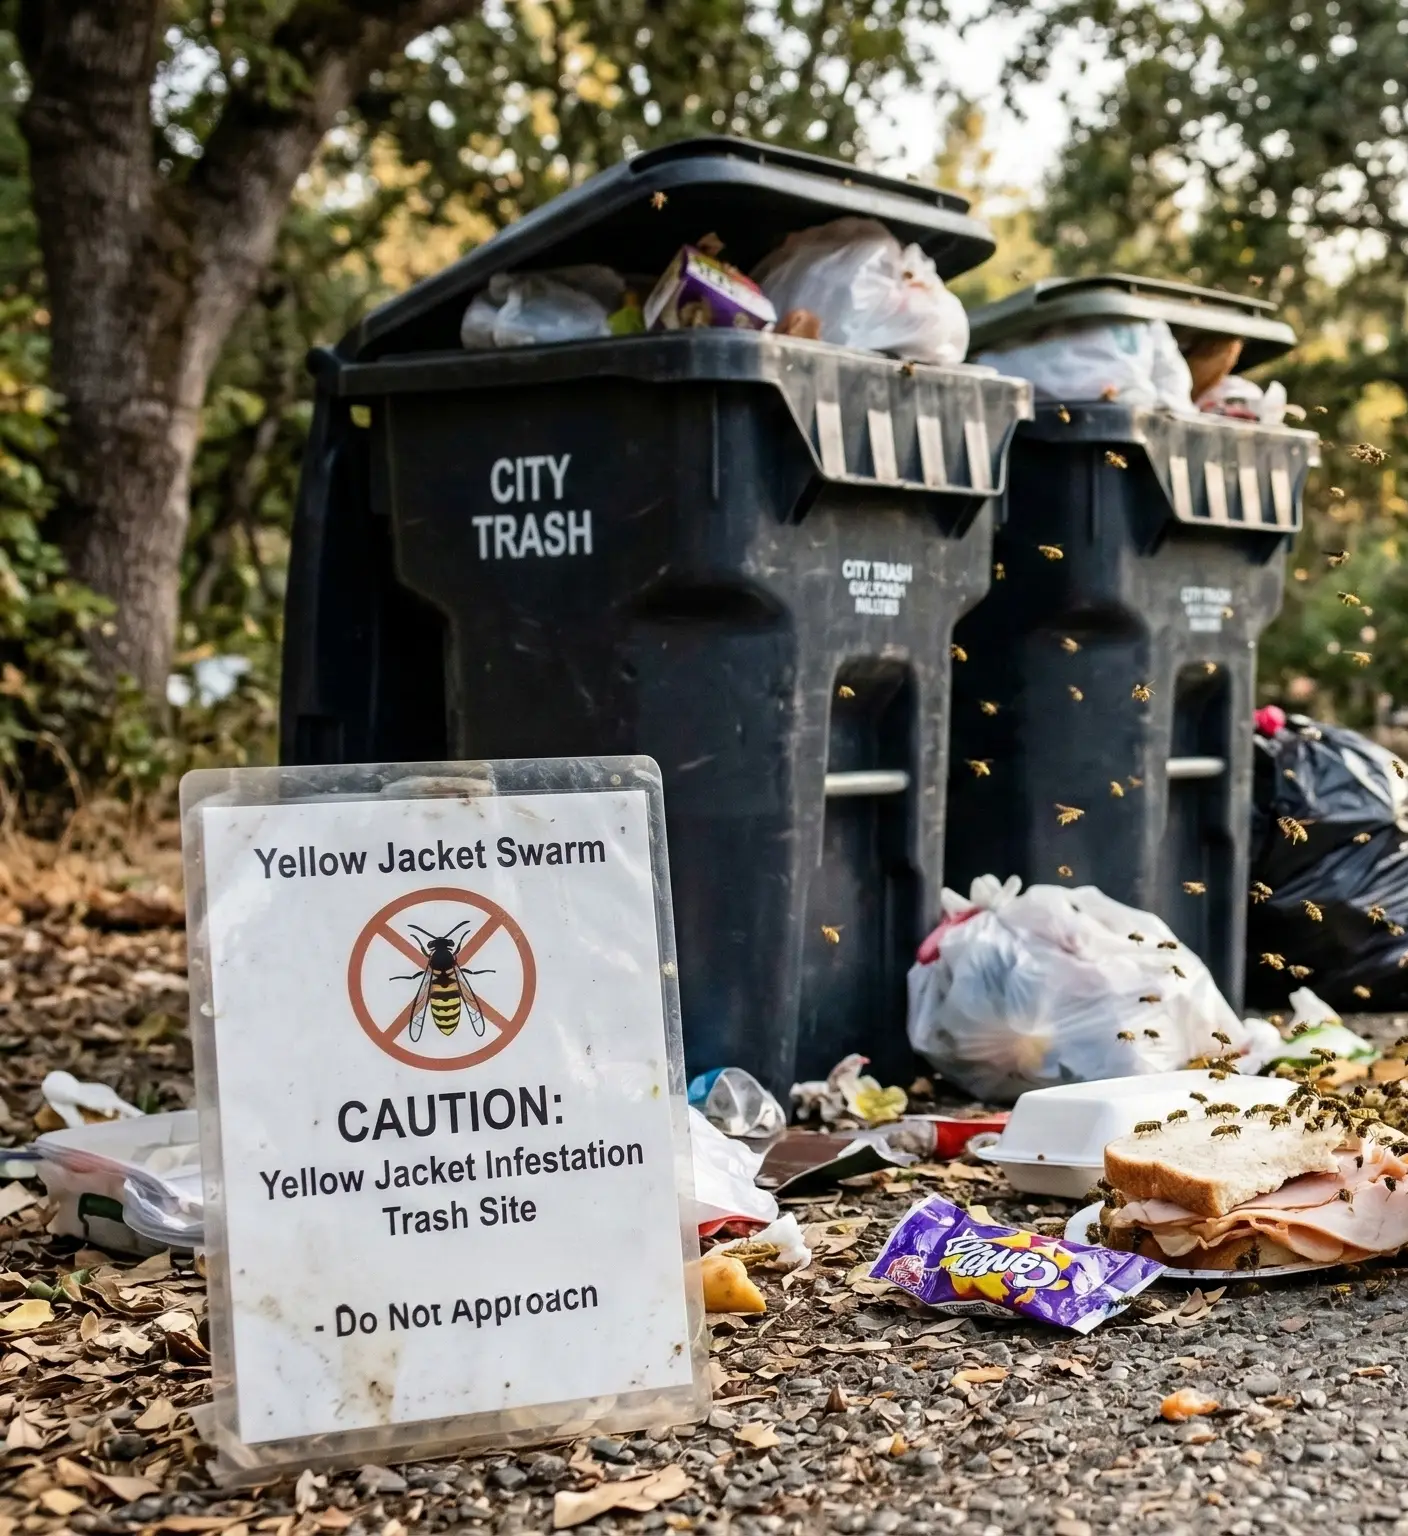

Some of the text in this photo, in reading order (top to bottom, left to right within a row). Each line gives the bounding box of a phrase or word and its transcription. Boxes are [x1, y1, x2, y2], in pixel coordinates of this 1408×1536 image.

[490, 453, 572, 504] CITY
[471, 509, 593, 560] TRASH
[842, 559, 913, 583] CITY TRASH
[253, 836, 607, 879] Yellow Jacket Swarm
[338, 1085, 564, 1143] CAUTION:
[259, 1139, 644, 1201] Yellow Jacket Infestation
[382, 1195, 538, 1237] Trash Site
[335, 1303, 378, 1337] Do
[389, 1302, 442, 1331] Not
